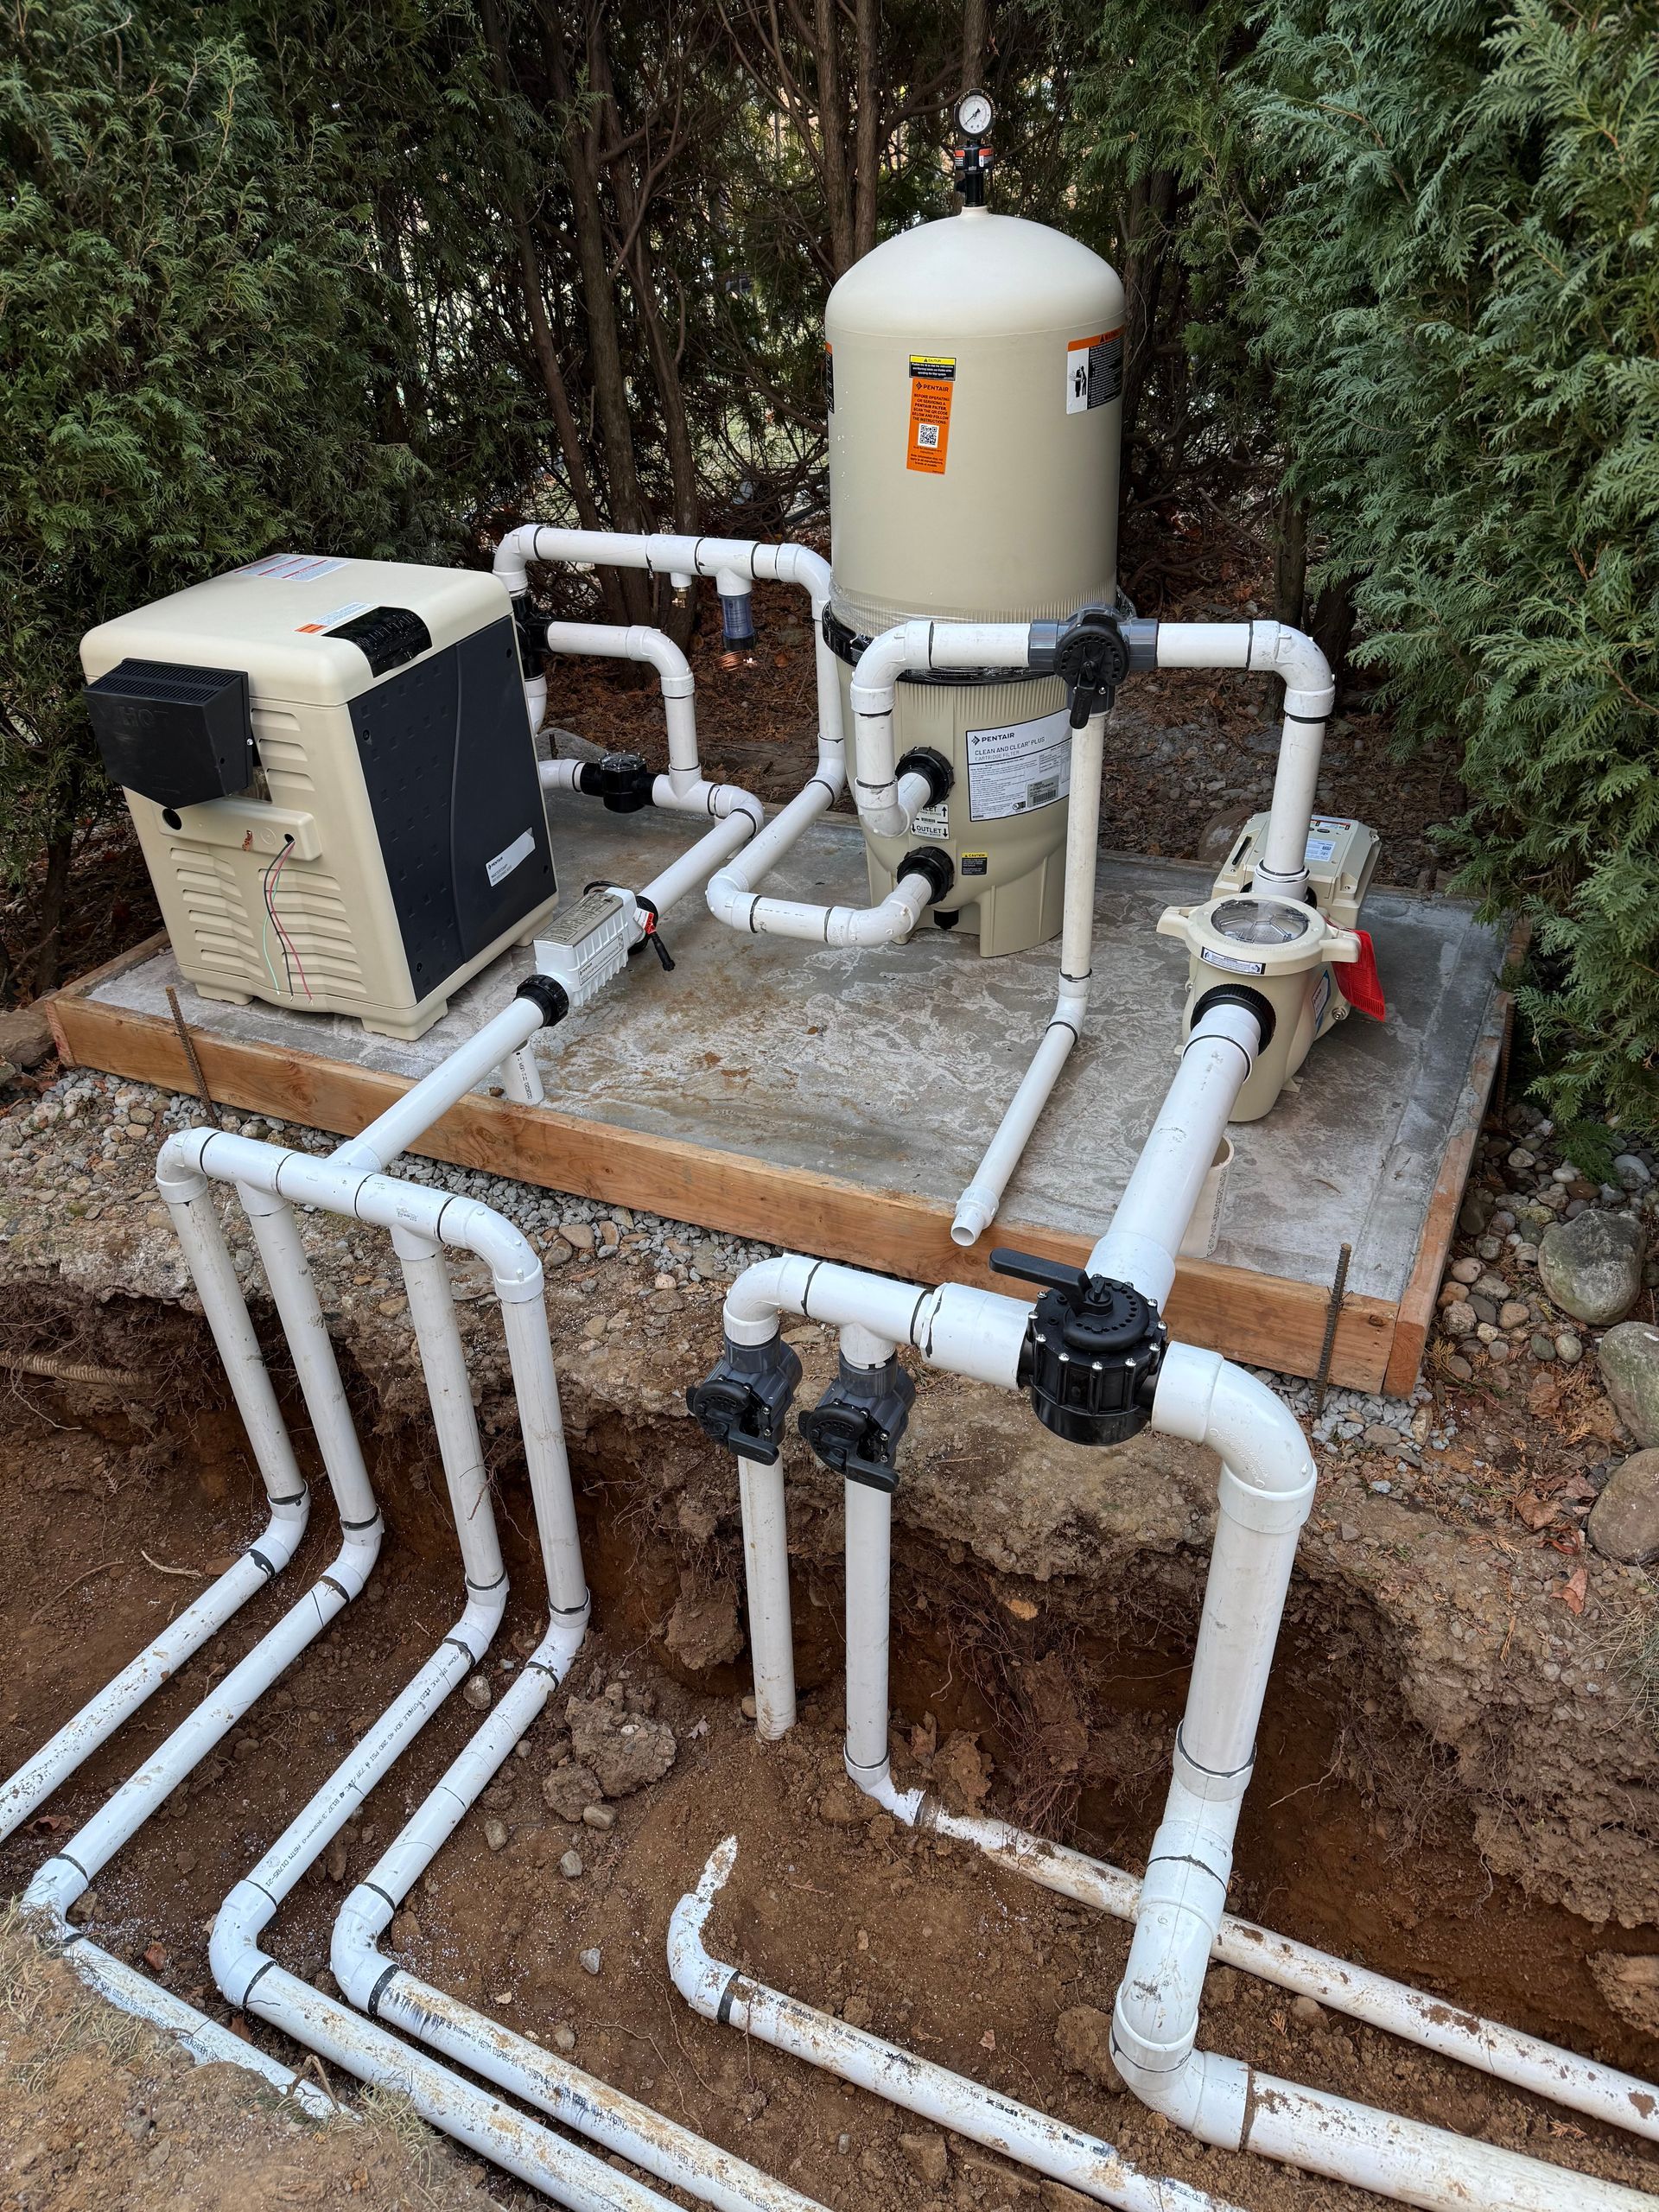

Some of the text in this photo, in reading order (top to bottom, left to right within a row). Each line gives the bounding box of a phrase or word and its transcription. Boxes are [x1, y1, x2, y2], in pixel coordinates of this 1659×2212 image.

[982, 733, 1014, 742] PENTAIR
[917, 825, 942, 834] OUTLET
[438, 1667, 448, 1678] IPS
[429, 1676, 441, 1688] PVC
[402, 1699, 422, 1721] POTABLE
[392, 1720, 404, 1732] SCH
[386, 1731, 395, 1739] 40
[369, 1750, 379, 1761] PSI
[287, 1843, 302, 1859] ASTM
[983, 2095, 1019, 2118] IPEX
[476, 2037, 493, 2052] ASTM
[711, 2172, 739, 2193] LISTED
